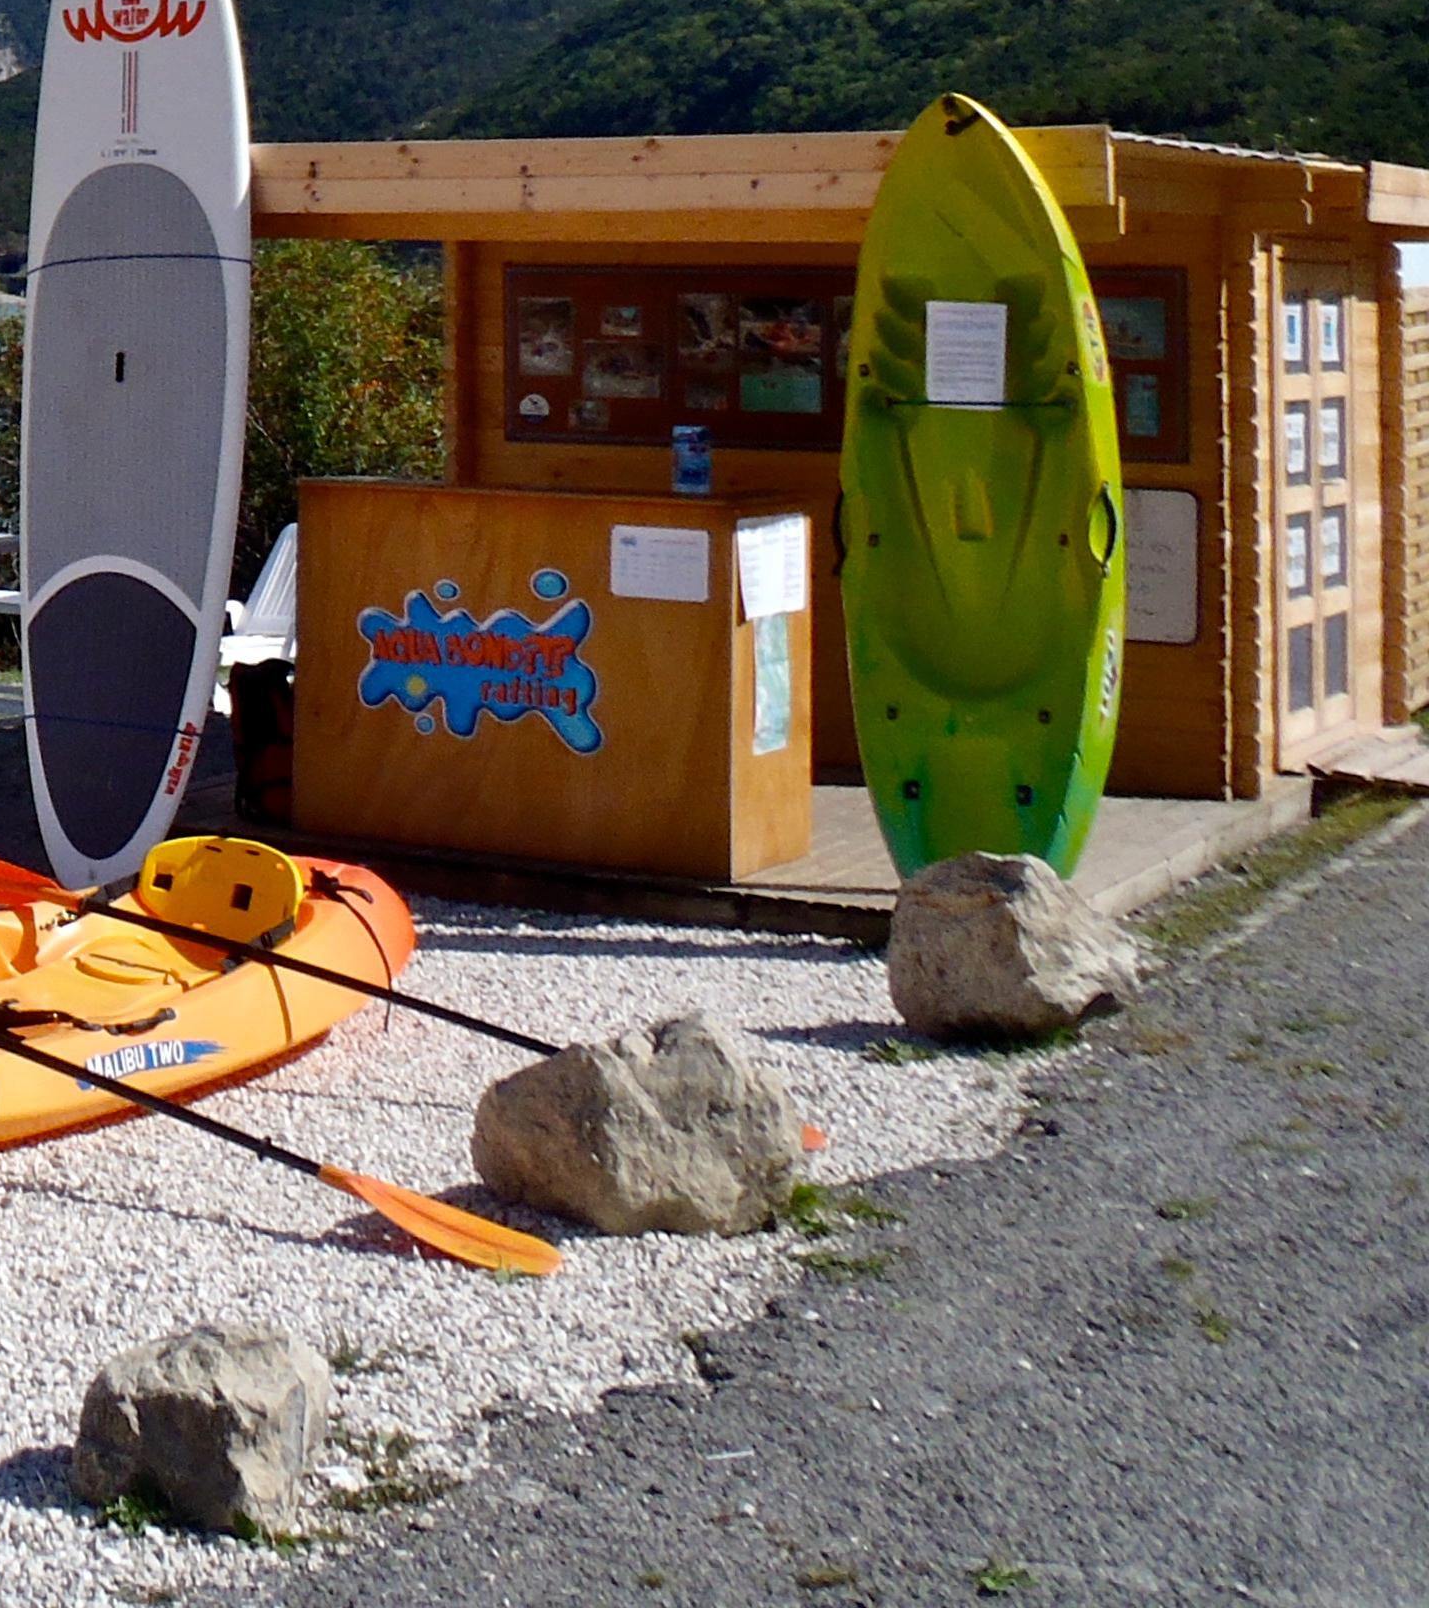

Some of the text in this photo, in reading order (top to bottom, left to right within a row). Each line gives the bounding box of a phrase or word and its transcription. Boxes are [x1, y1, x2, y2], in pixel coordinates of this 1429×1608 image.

[112, 6, 149, 27] water
[373, 628, 442, 665] AQUA
[481, 677, 577, 716] rafting
[148, 1040, 185, 1068] TWO
